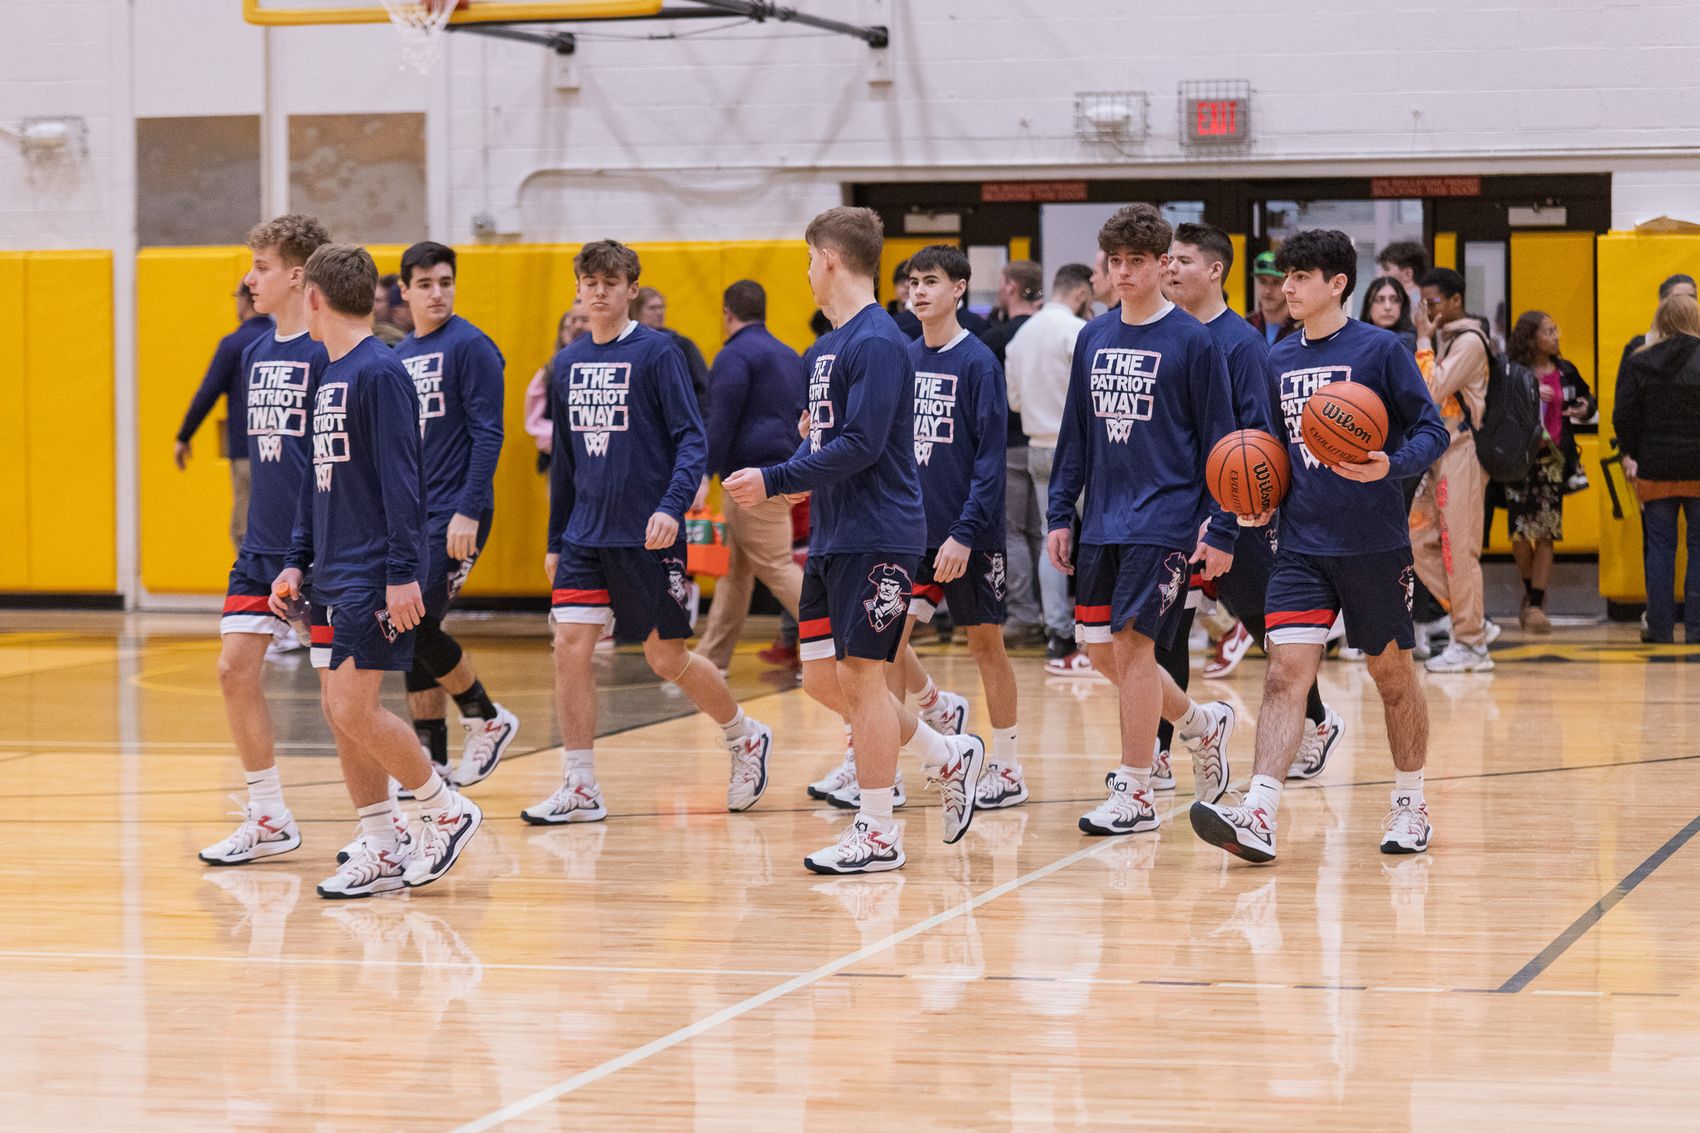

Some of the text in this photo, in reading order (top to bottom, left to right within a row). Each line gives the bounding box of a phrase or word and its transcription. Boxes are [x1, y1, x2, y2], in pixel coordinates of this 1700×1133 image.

[1198, 101, 1237, 135] EXIT
[1106, 353, 1144, 375] THE
[259, 367, 293, 389] THE
[580, 368, 616, 389] THE
[1091, 374, 1155, 394] PATRIOT
[248, 389, 307, 408] PATRIOT
[568, 389, 629, 405] PATRIOT
[1100, 391, 1140, 414] WAY
[251, 407, 291, 431] WAY
[579, 405, 616, 427] WAY
[1321, 400, 1372, 445] Wilson
